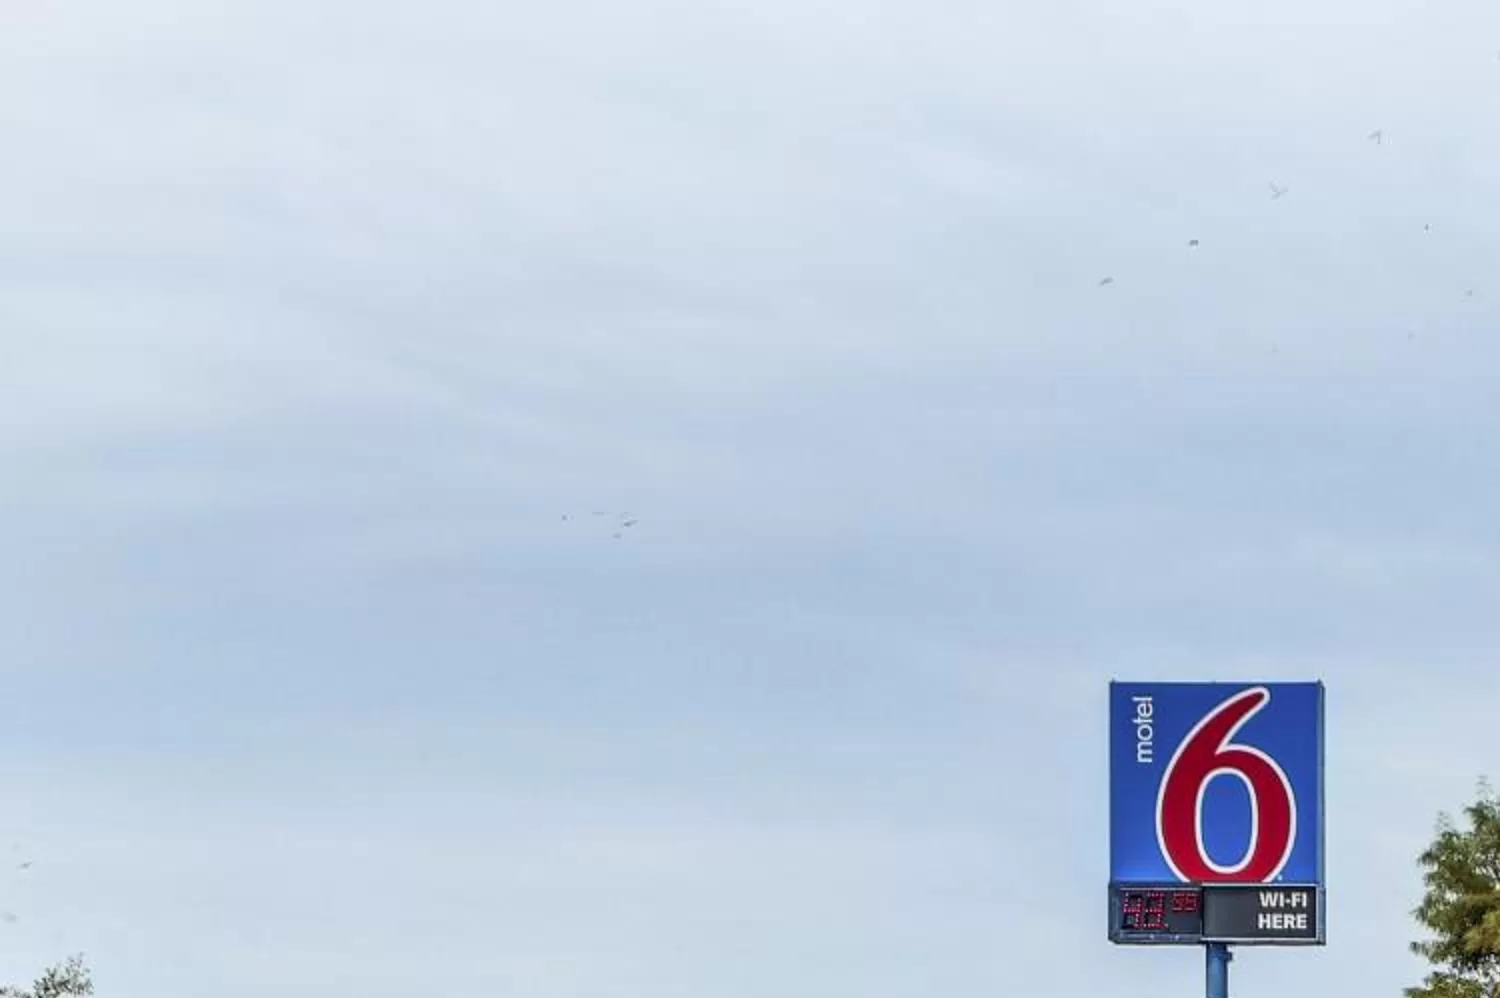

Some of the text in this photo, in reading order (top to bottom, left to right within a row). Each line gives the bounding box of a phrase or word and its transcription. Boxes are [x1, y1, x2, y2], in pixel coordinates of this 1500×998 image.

[1132, 696, 1153, 763] motel
[1156, 686, 1296, 884] 6
[1259, 891, 1307, 908] WI-FI
[1258, 913, 1307, 929] HERE
